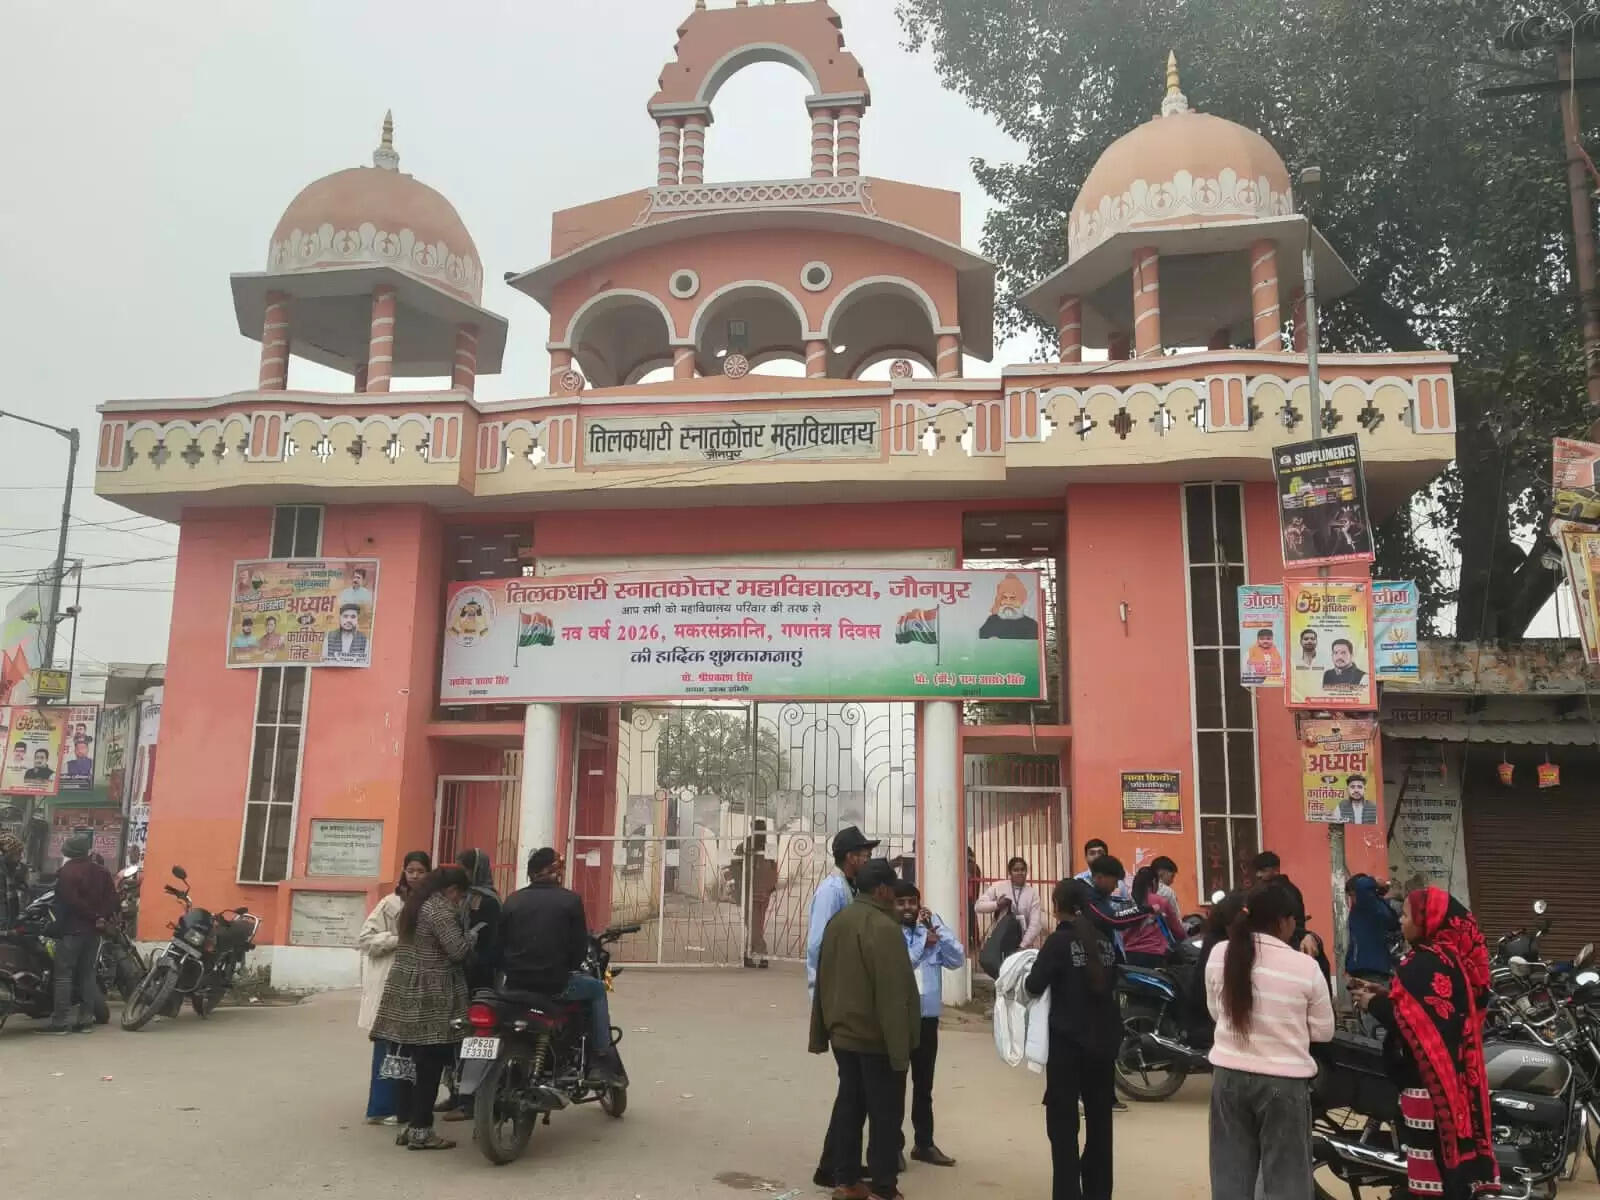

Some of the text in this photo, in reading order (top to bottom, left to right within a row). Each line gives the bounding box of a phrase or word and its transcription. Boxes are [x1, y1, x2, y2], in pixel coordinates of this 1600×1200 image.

[588, 416, 877, 453] तिलकधारी स्नातकोत्तर महाविद्यालय
[1294, 445, 1356, 466] SUPPLIMENTS
[505, 574, 972, 605] तिलकधारी स्नातकोत्तर महाविद्यालय, जौनपुर
[286, 596, 336, 613] अध्यक्ष
[622, 600, 822, 616] आप सभी को महाविद्यालय परिवार की तरफ से
[561, 625, 583, 641] नव
[588, 620, 612, 641] वर्ष
[617, 623, 666, 643] 2026,
[781, 617, 831, 640] गणतंत्र
[838, 617, 881, 640] दिवस
[630, 645, 803, 668] की हार्दिक शुभकामनाएं
[1309, 753, 1368, 772] अध्यक्ष
